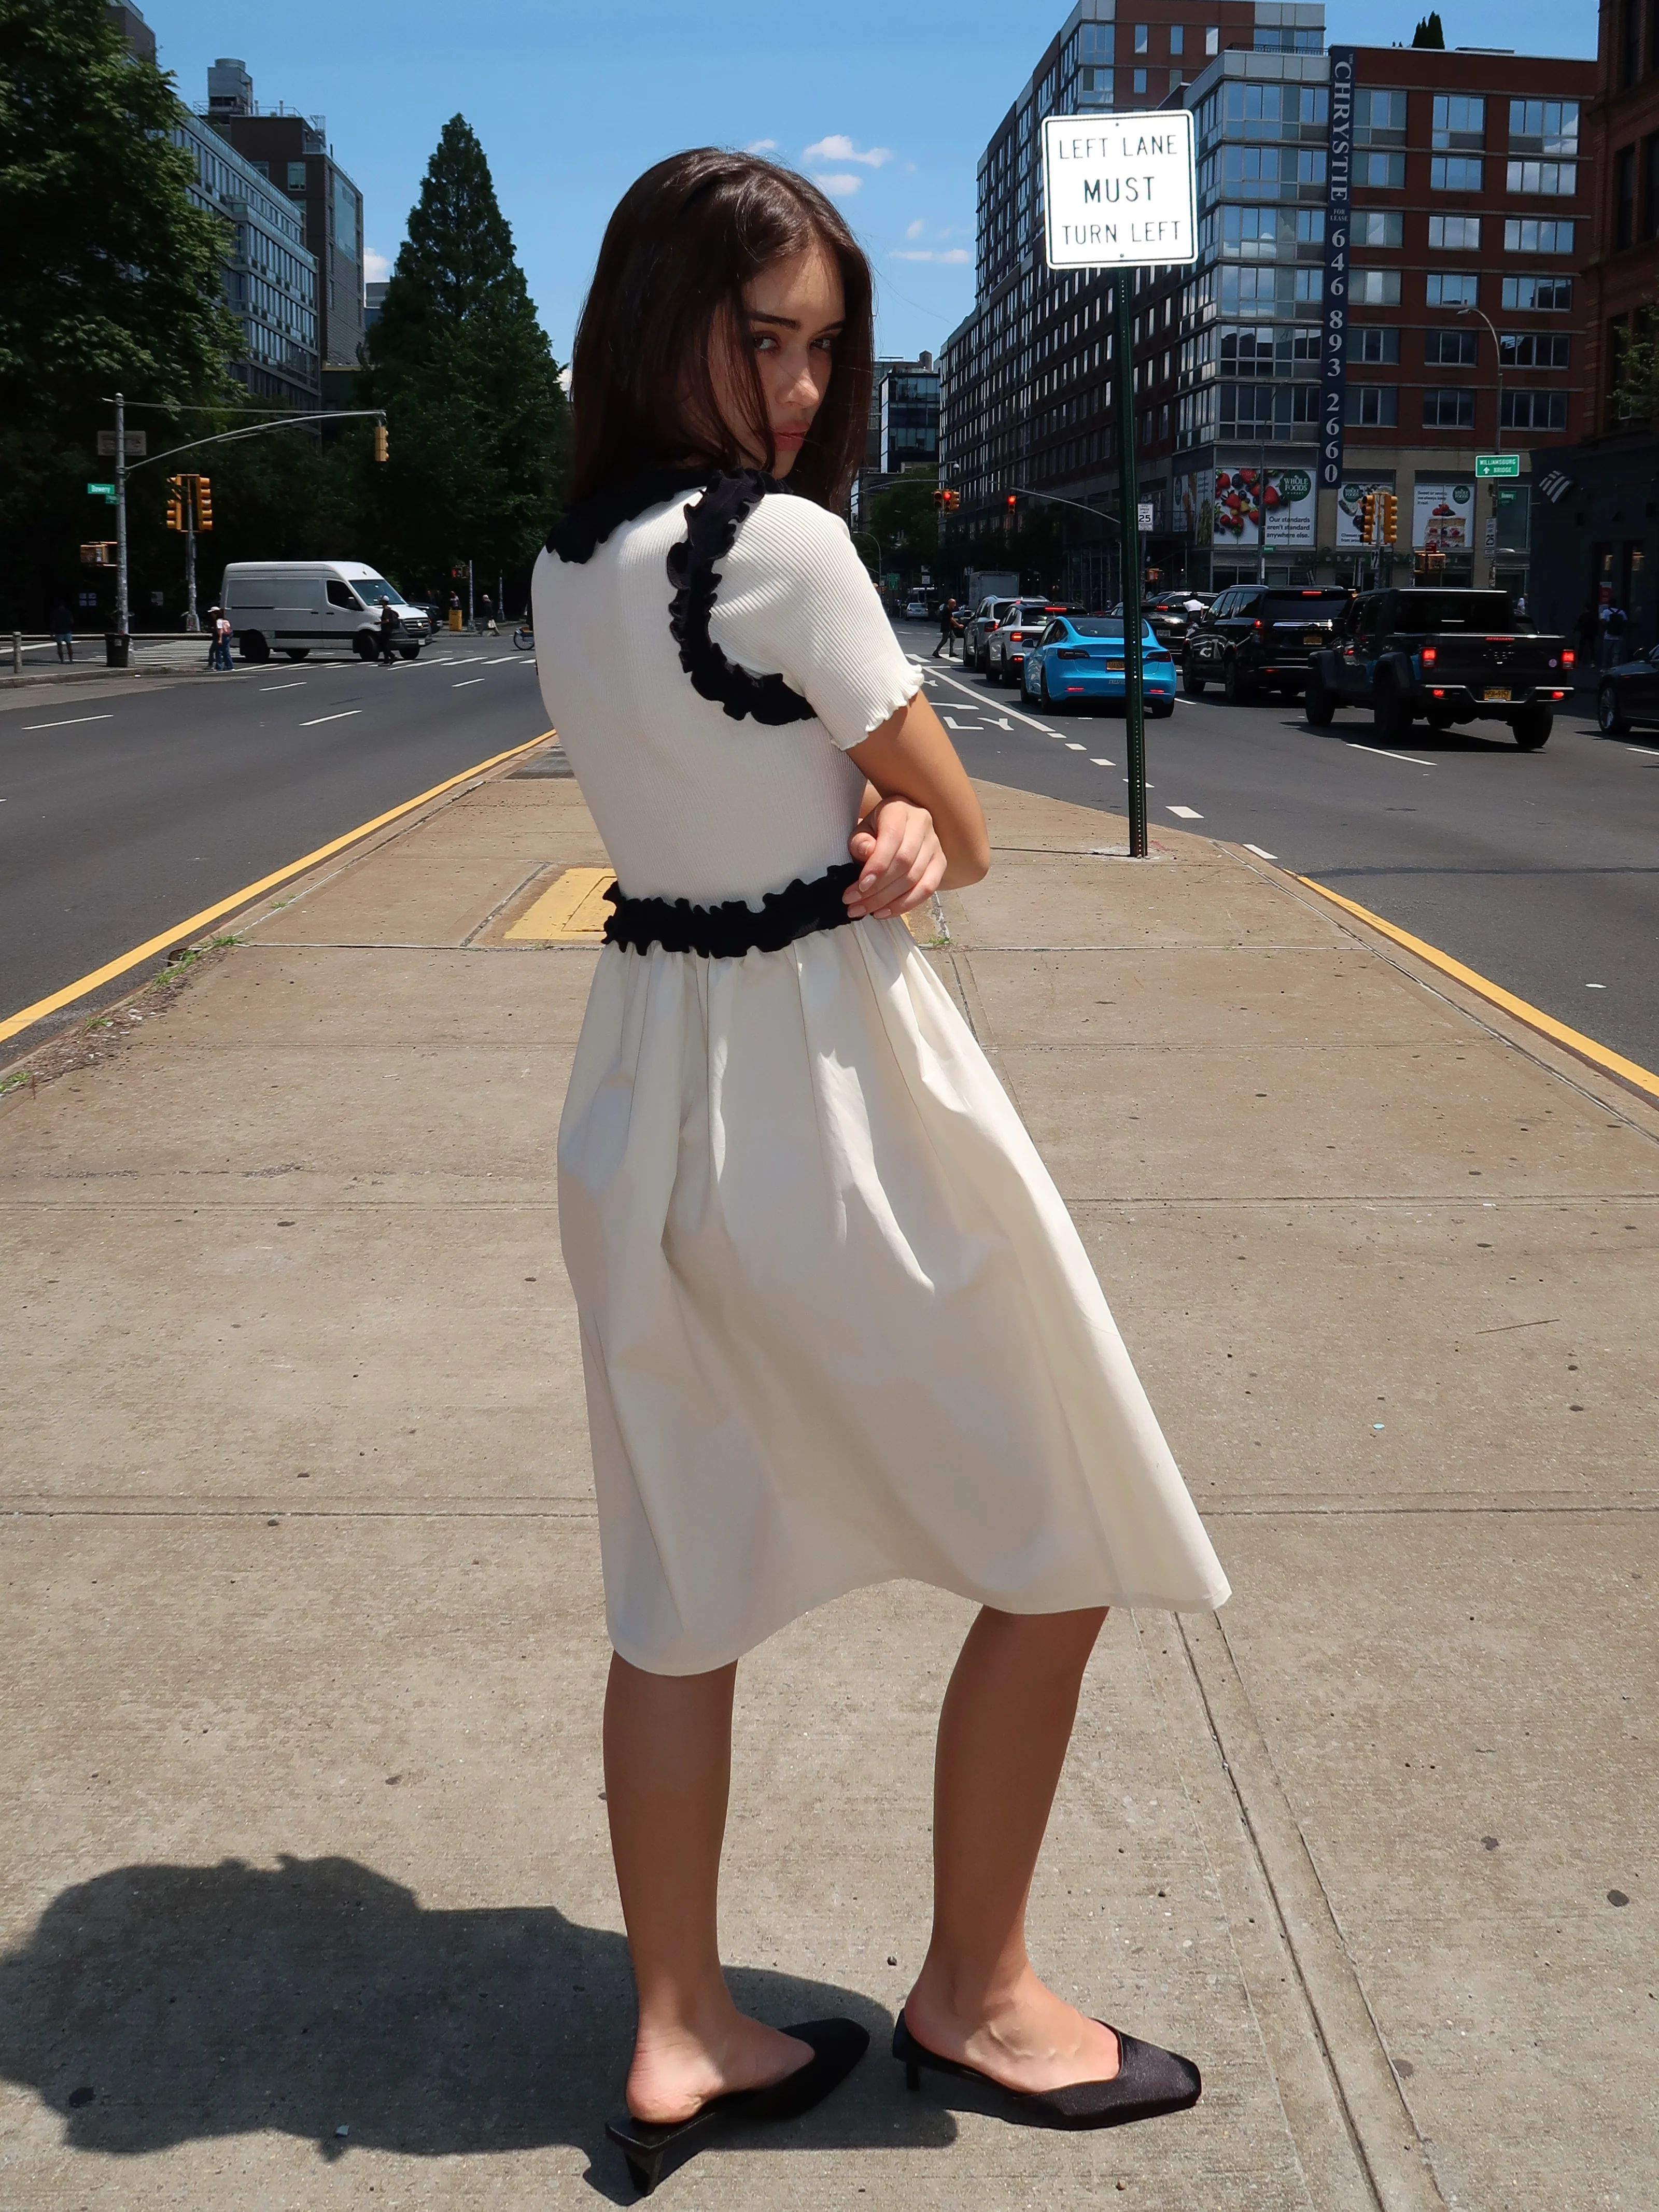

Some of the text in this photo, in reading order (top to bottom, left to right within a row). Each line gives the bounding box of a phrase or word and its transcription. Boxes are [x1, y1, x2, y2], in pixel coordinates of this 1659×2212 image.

[1330, 61, 1351, 201] CHRYSTIE
[1059, 135, 1177, 159] LEFT LANE
[1084, 176, 1155, 203] MUST
[1062, 221, 1180, 245] TURN LEFT
[1486, 534, 1494, 545] 25
